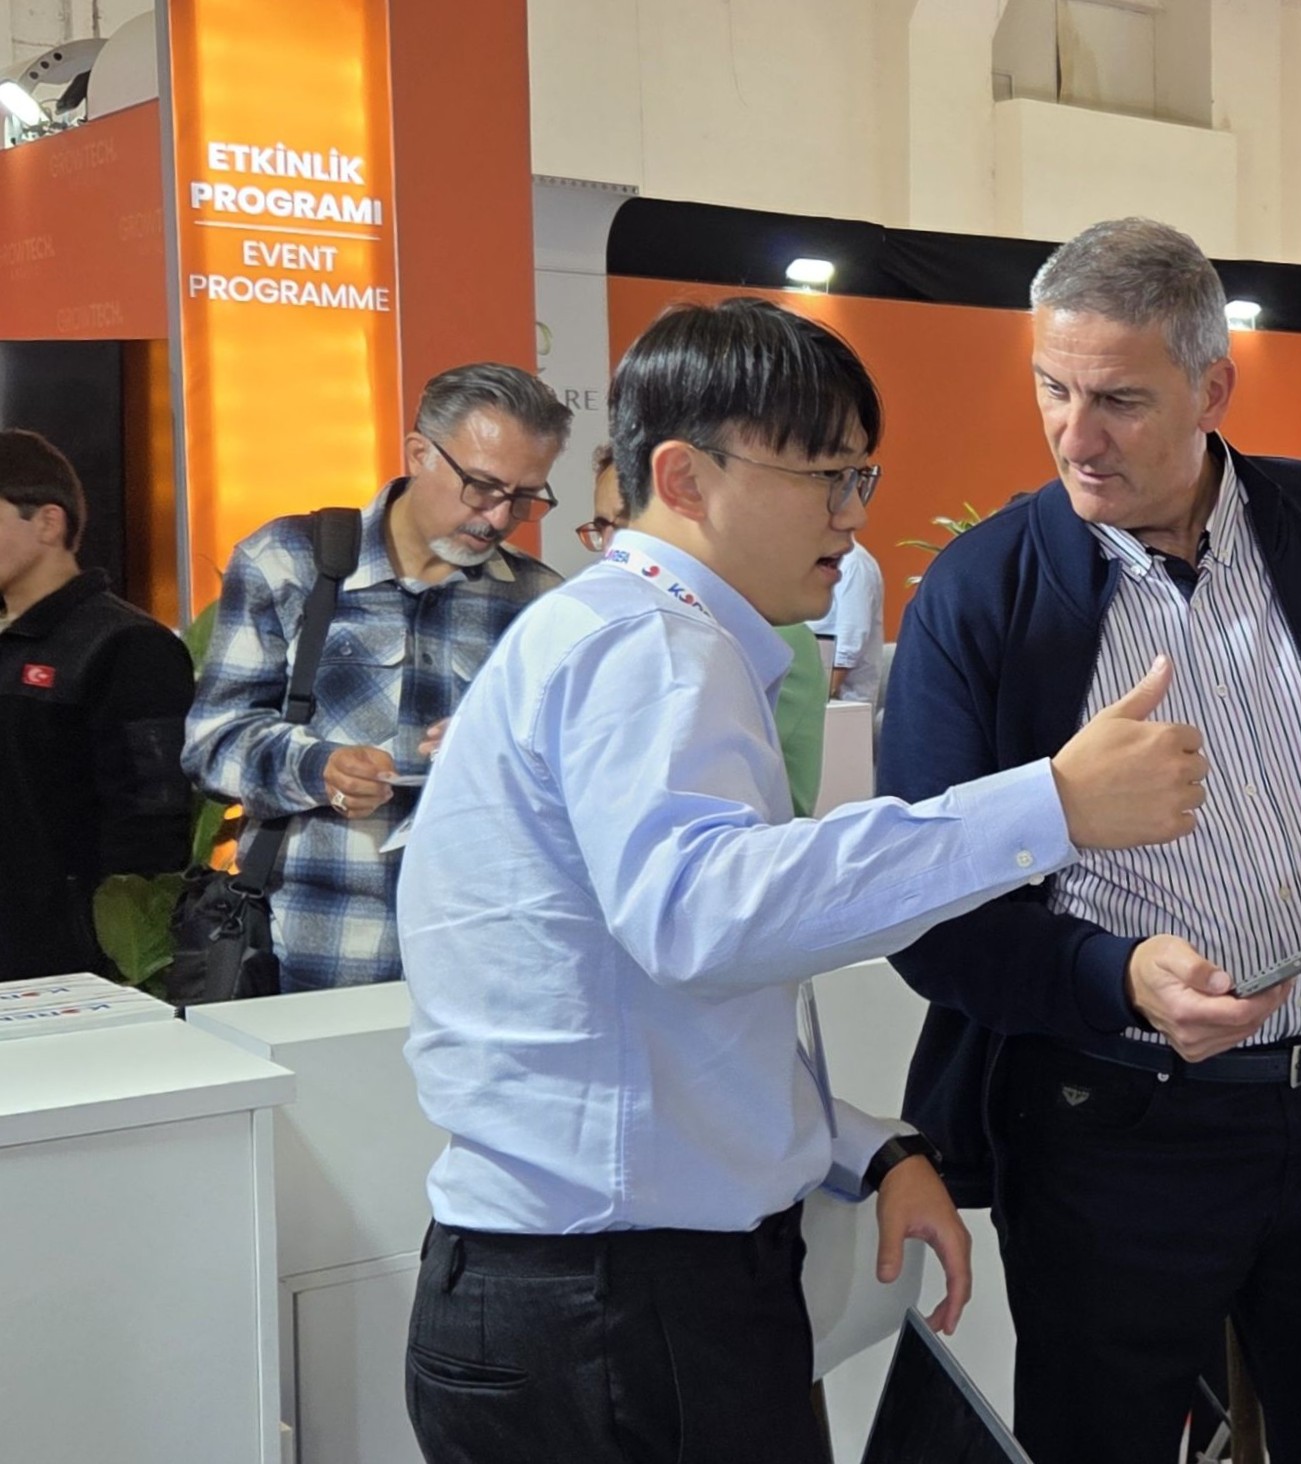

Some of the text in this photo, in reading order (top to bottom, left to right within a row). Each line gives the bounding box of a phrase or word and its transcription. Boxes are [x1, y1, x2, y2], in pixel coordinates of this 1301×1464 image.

[208, 141, 366, 185] ETKİNLİK
[190, 181, 382, 225] PROGRAMI
[242, 240, 338, 272] EVENT
[189, 273, 390, 311] PROGRAMME
